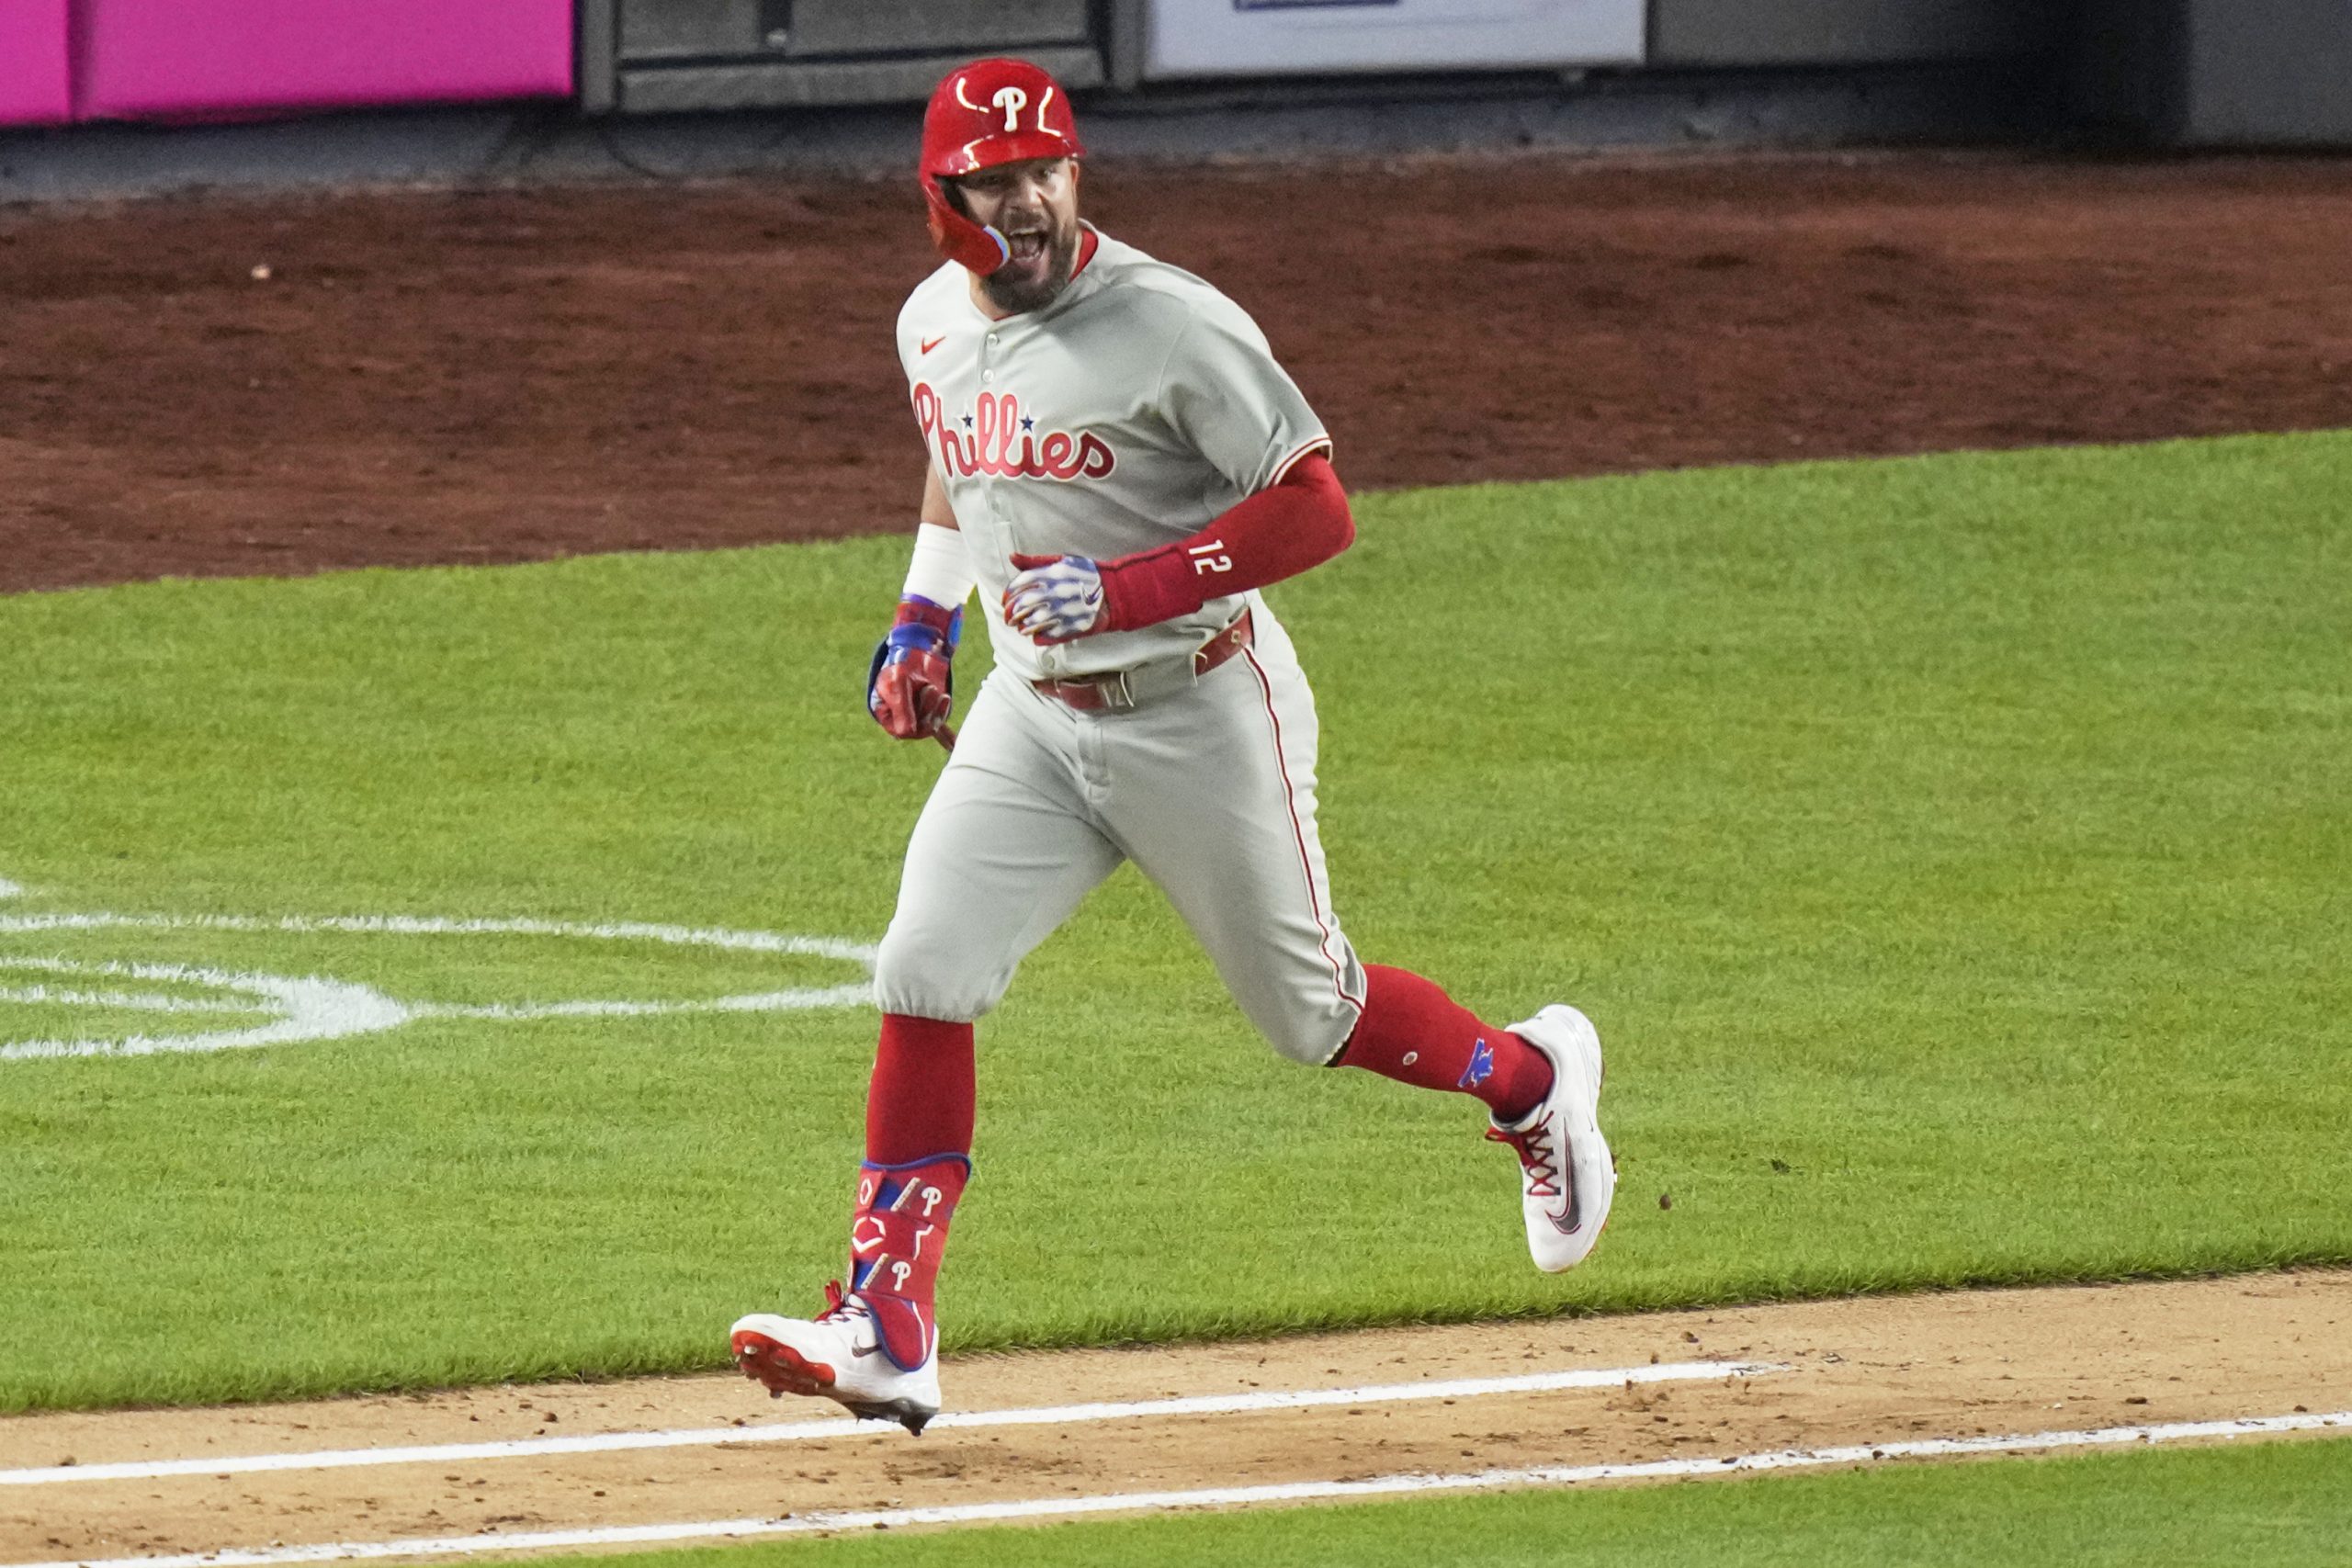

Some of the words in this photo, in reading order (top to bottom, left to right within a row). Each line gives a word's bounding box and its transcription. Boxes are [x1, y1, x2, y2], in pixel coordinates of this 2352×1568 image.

[992, 86, 1027, 131] P
[913, 381, 1115, 481] Phillies
[1188, 539, 1232, 575] 12
[922, 1186, 942, 1217] P
[891, 1261, 911, 1292] P
